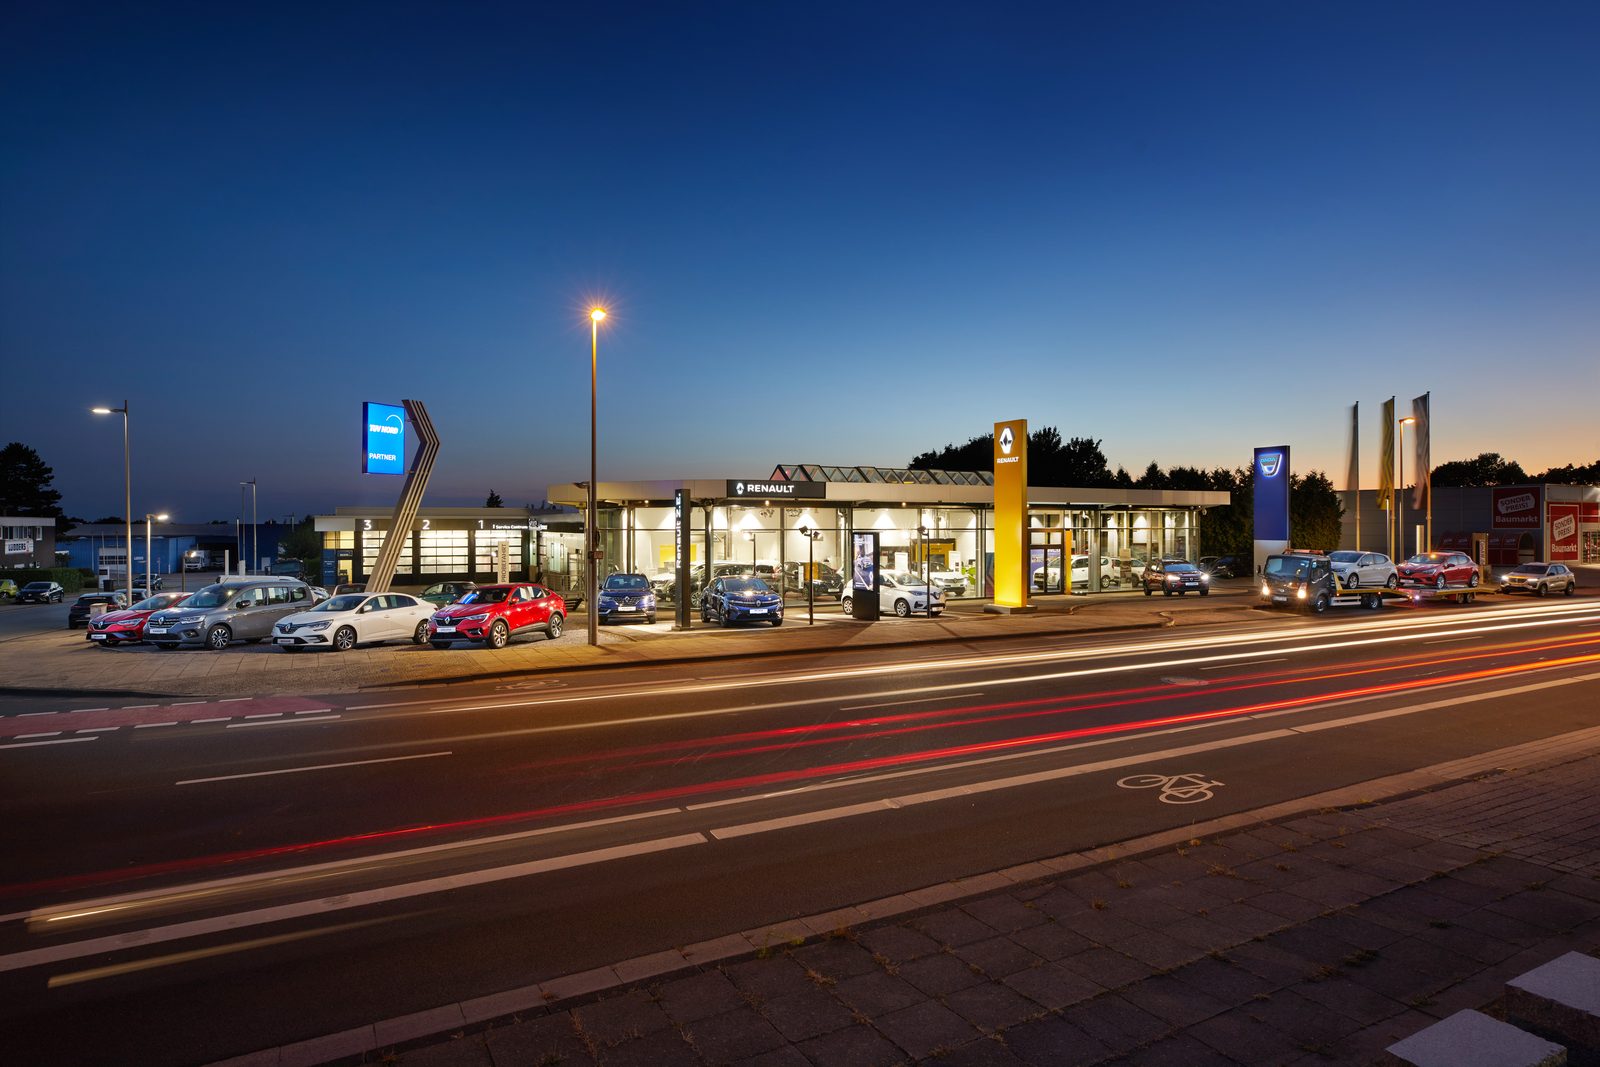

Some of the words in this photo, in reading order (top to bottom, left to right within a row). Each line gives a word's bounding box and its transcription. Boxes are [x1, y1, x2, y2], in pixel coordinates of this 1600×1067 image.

[381, 425, 399, 435] NORD
[369, 453, 396, 461] PARTNER
[748, 484, 794, 493] RENAULT
[1500, 495, 1532, 506] SONDER
[1496, 515, 1538, 523] Baumarkt
[1554, 517, 1573, 531] SONDER
[363, 519, 372, 530] 3
[422, 519, 430, 530] 2
[478, 519, 484, 530] 1
[1551, 543, 1577, 553] Baumarkt
